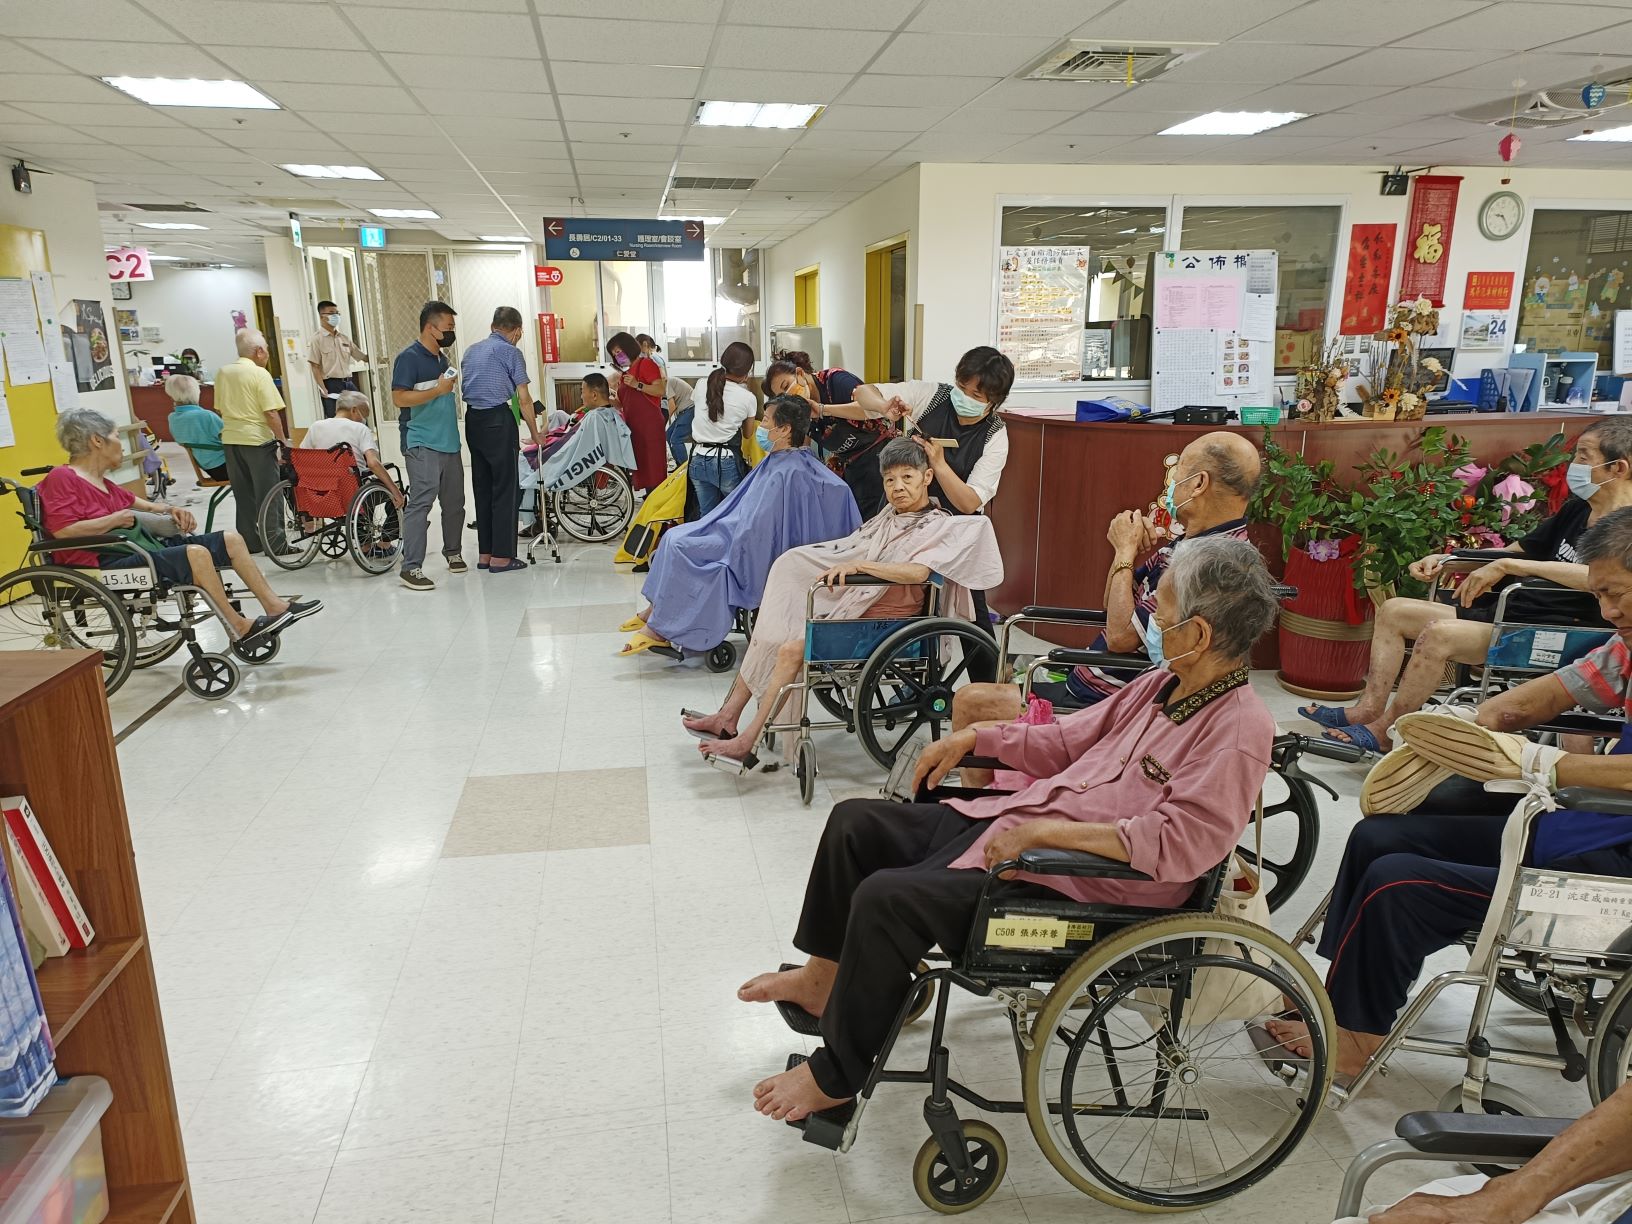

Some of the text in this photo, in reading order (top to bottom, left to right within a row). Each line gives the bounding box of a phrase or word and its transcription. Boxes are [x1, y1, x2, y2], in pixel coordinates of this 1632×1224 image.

[1413, 223, 1443, 264] 福
[106, 253, 145, 279] C2
[1489, 319, 1506, 335] 24
[102, 573, 148, 586] 15.1kg
[1530, 887, 1560, 899] D2-21
[995, 927, 1016, 937] C508
